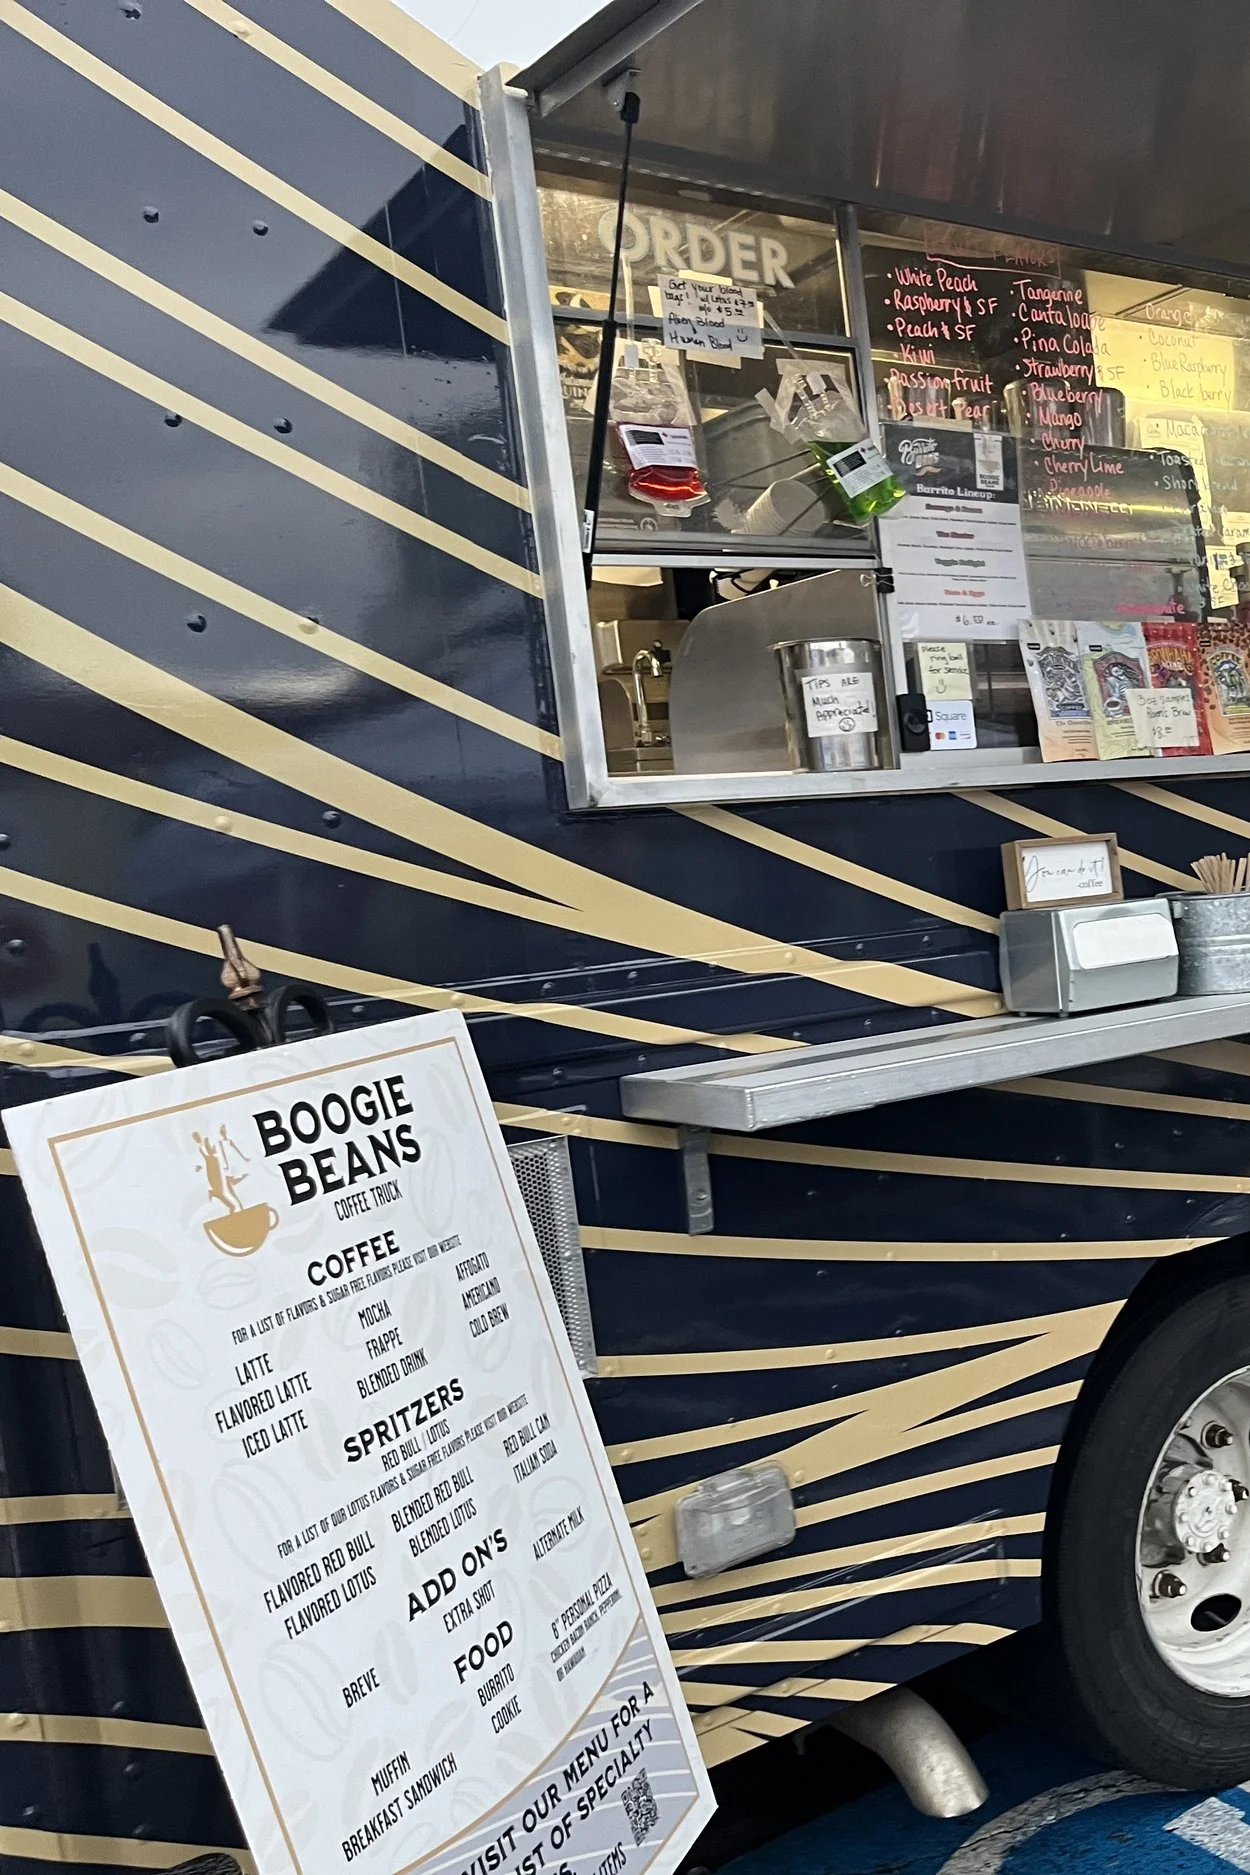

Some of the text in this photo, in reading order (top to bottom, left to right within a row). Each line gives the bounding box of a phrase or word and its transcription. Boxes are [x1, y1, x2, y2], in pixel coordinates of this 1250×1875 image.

[598, 207, 795, 289] ORDER
[668, 279, 687, 290] Get
[691, 282, 714, 298] your
[895, 267, 978, 292] White Peach
[894, 289, 998, 322] Raspberry SF
[1146, 303, 1193, 326] Orange
[895, 318, 976, 341] Peach SF
[1022, 328, 1111, 357] Pina Colada
[1148, 328, 1197, 349] Coconut
[900, 344, 935, 364] Kiwi
[1022, 359, 1095, 385] Strawberry
[1032, 384, 1103, 408] Blueberry
[1039, 409, 1082, 430] Mango
[1042, 432, 1085, 460] Cherry
[1044, 452, 1124, 482] Cherry Lime
[916, 483, 996, 500] Burrito Lineup:
[805, 678, 831, 690] TIPS
[935, 711, 967, 723] Square
[252, 1075, 414, 1157] BOOGIE
[278, 1124, 421, 1205] BEANS
[334, 1179, 403, 1221] COFFEE TRUCK
[307, 1230, 400, 1286] COFFEE
[455, 1251, 490, 1282] AFFOGATO
[231, 1327, 249, 1345] FOR
[249, 1324, 257, 1338] A
[256, 1316, 275, 1335] LIST
[275, 1311, 286, 1327] OF
[286, 1298, 318, 1322] FLAVORS
[318, 1294, 326, 1307] &
[326, 1284, 350, 1304] SUGAR
[350, 1277, 366, 1297] FREE
[366, 1265, 393, 1287] FLAVORS
[392, 1256, 413, 1275] PLEASE
[357, 1299, 392, 1330] MOCHA
[461, 1277, 501, 1311] AMERICANO
[469, 1302, 510, 1338] COLD BREW
[366, 1327, 403, 1360] FRAPPE
[235, 1353, 273, 1386] LATTE
[356, 1347, 429, 1400] BLENDED DRINK
[215, 1371, 312, 1433] FLAVORED LATTE
[343, 1378, 464, 1463] SPRITZERS
[241, 1409, 309, 1458] ICED LATTE
[381, 1419, 451, 1472] RED BULL LOTUS
[503, 1412, 551, 1457] RED BULL CAN
[512, 1440, 558, 1484] ITALIAN SODA
[277, 1539, 294, 1558] FOR
[294, 1535, 302, 1549] A
[301, 1524, 319, 1544] LIST
[319, 1517, 330, 1533] OF
[330, 1508, 347, 1527] OUR
[346, 1494, 371, 1517] LOTUS
[369, 1476, 400, 1504] FLAVORS
[399, 1472, 407, 1485] &
[406, 1459, 427, 1481] SUGAR
[427, 1450, 443, 1469] FREE
[464, 1422, 485, 1443] PLEASE
[391, 1466, 474, 1533] BLENDED RED BULL
[409, 1498, 477, 1558] BLENDED LOTUS
[532, 1505, 585, 1561] ALTERNATE MILK
[263, 1531, 376, 1613] FLAVORED RED BULL
[405, 1528, 508, 1622] ADD ON'S
[284, 1566, 377, 1640] FLAVORED LOTUS
[442, 1580, 497, 1633] EXTRA SHOT
[561, 1589, 595, 1631] PERSONAL
[592, 1571, 613, 1601] PIZZA
[453, 1621, 514, 1685] FOOD
[342, 1667, 381, 1709] BREVE
[476, 1663, 515, 1707] BURRITO
[490, 1695, 522, 1734] COOKIE
[370, 1751, 411, 1797] MUFFIN
[521, 1680, 655, 1833] OUR MENU FOR A
[550, 1811, 573, 1850] OF
[576, 1719, 654, 1821] SPECIALTY
[341, 1752, 458, 1863] BREAKFAST SANDWICH
